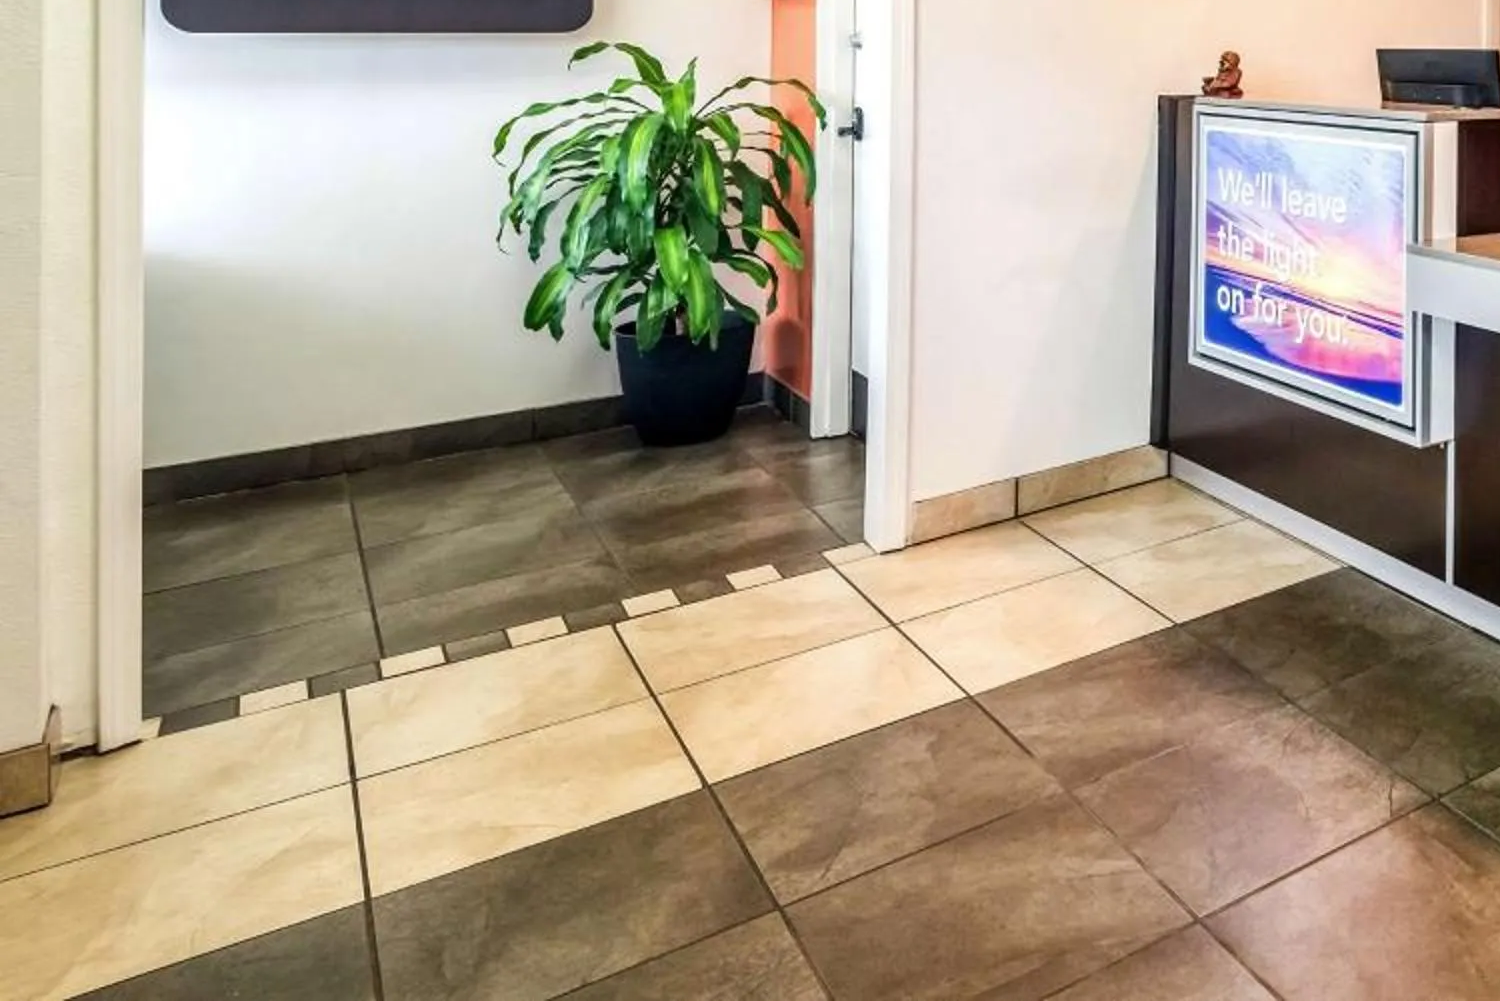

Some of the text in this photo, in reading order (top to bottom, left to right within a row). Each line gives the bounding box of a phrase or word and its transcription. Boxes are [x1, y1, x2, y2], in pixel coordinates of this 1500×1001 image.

[1218, 167, 1346, 222] We'll leave
[1217, 222, 1317, 281] the light
[1217, 284, 1245, 315] on
[1252, 281, 1288, 326] for
